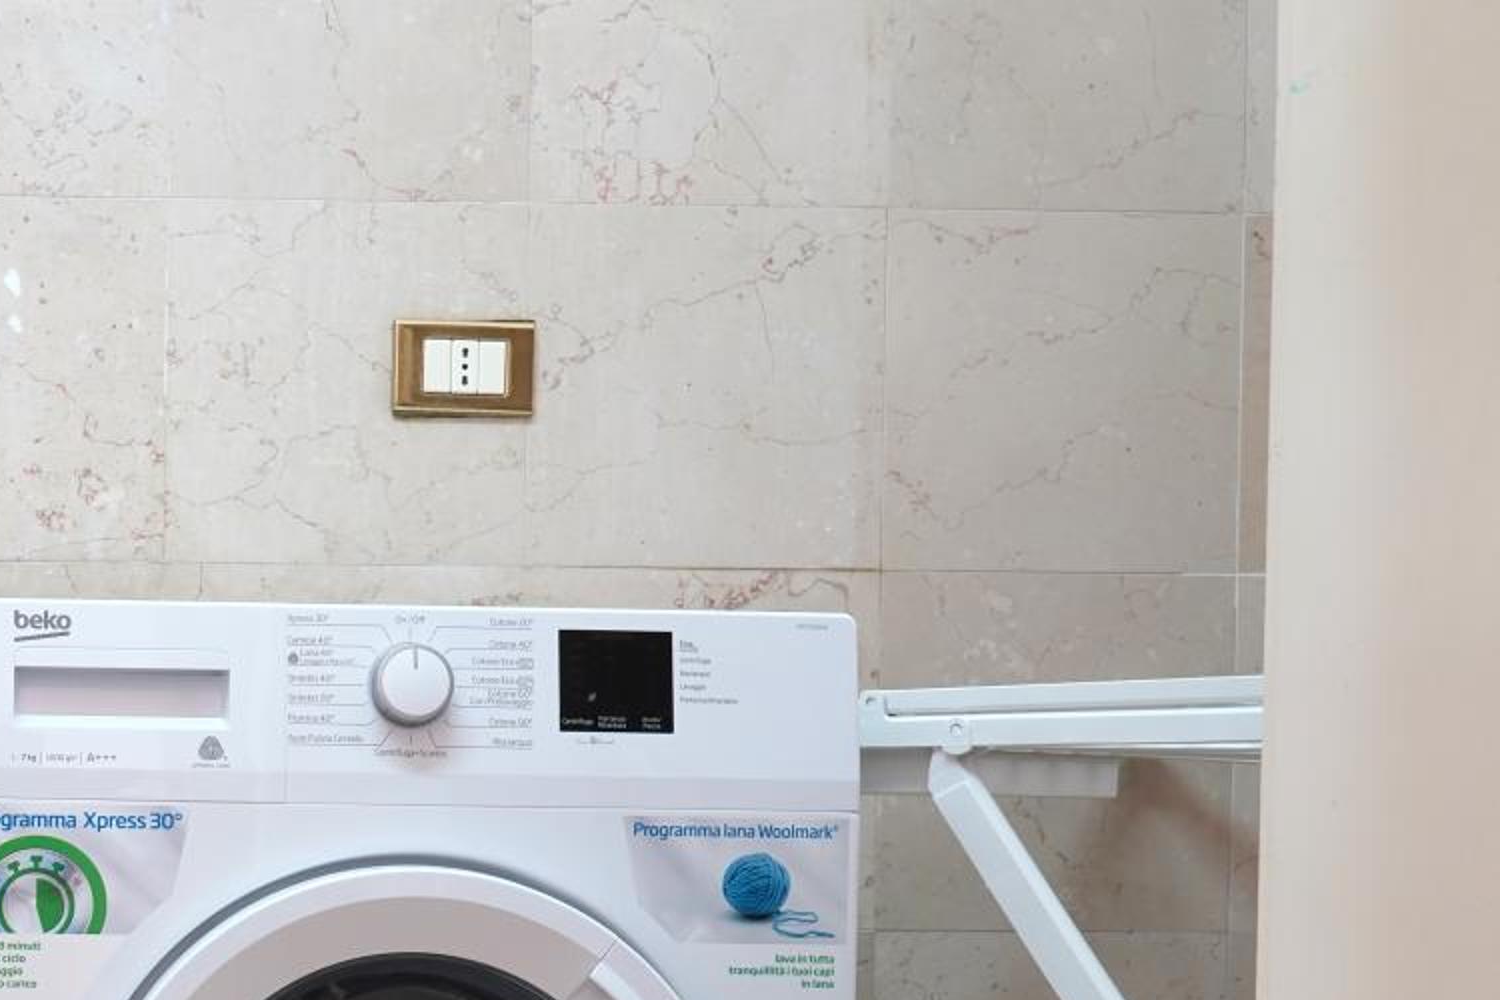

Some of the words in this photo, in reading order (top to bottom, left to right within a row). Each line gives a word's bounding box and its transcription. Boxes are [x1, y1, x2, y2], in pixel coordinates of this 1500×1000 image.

[13, 609, 72, 630] beko
[83, 812, 147, 832] Xpress
[150, 813, 183, 829] 30°
[633, 822, 720, 841] Programma
